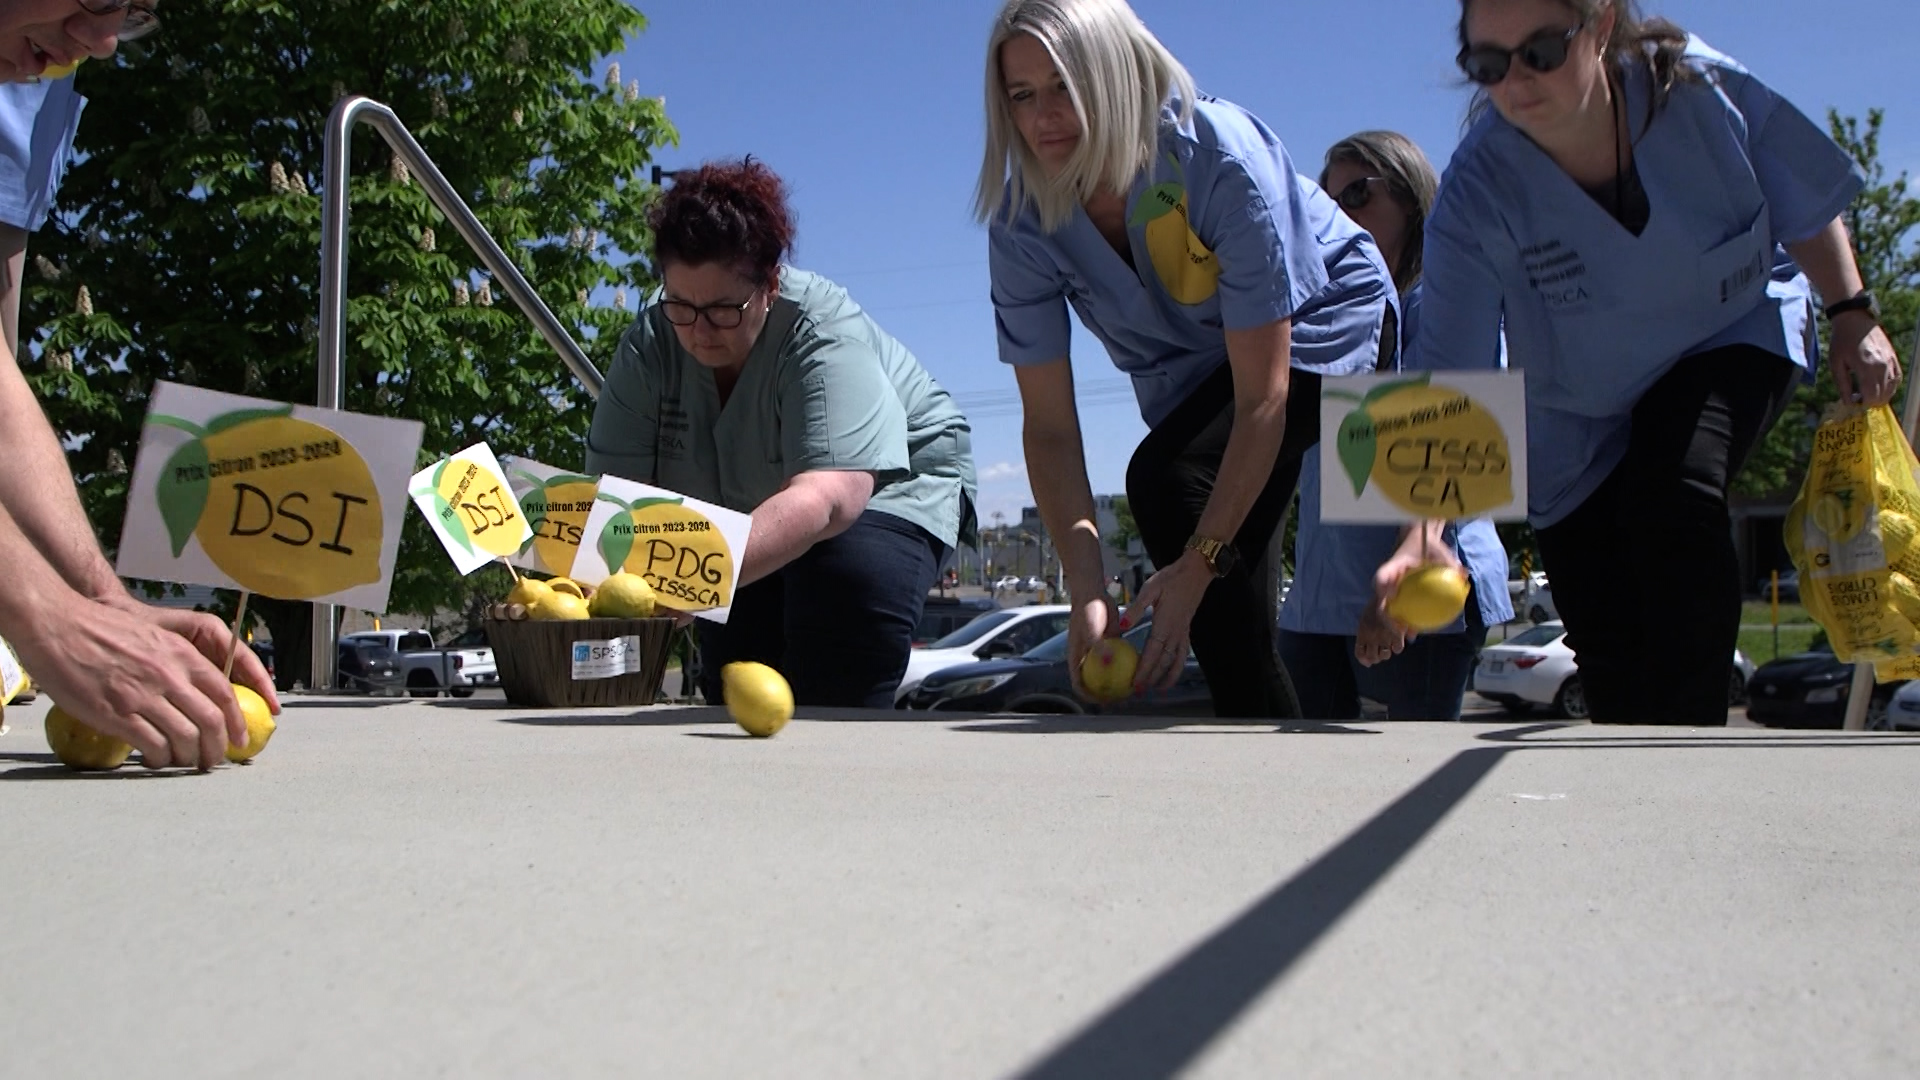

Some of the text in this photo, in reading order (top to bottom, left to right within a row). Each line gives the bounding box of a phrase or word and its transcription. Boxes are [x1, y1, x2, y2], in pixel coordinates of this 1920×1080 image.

[526, 501, 544, 513] Prix
[546, 501, 574, 513] citron
[1409, 475, 1465, 515] CA
[229, 482, 368, 555] DSI
[460, 485, 515, 536] DSI
[530, 517, 584, 546] CIS
[613, 521, 710, 535] Prix citron 2023-2024
[645, 538, 725, 585] PDG
[1827, 577, 1876, 594] CITROS
[1831, 589, 1878, 606] LEMOS
